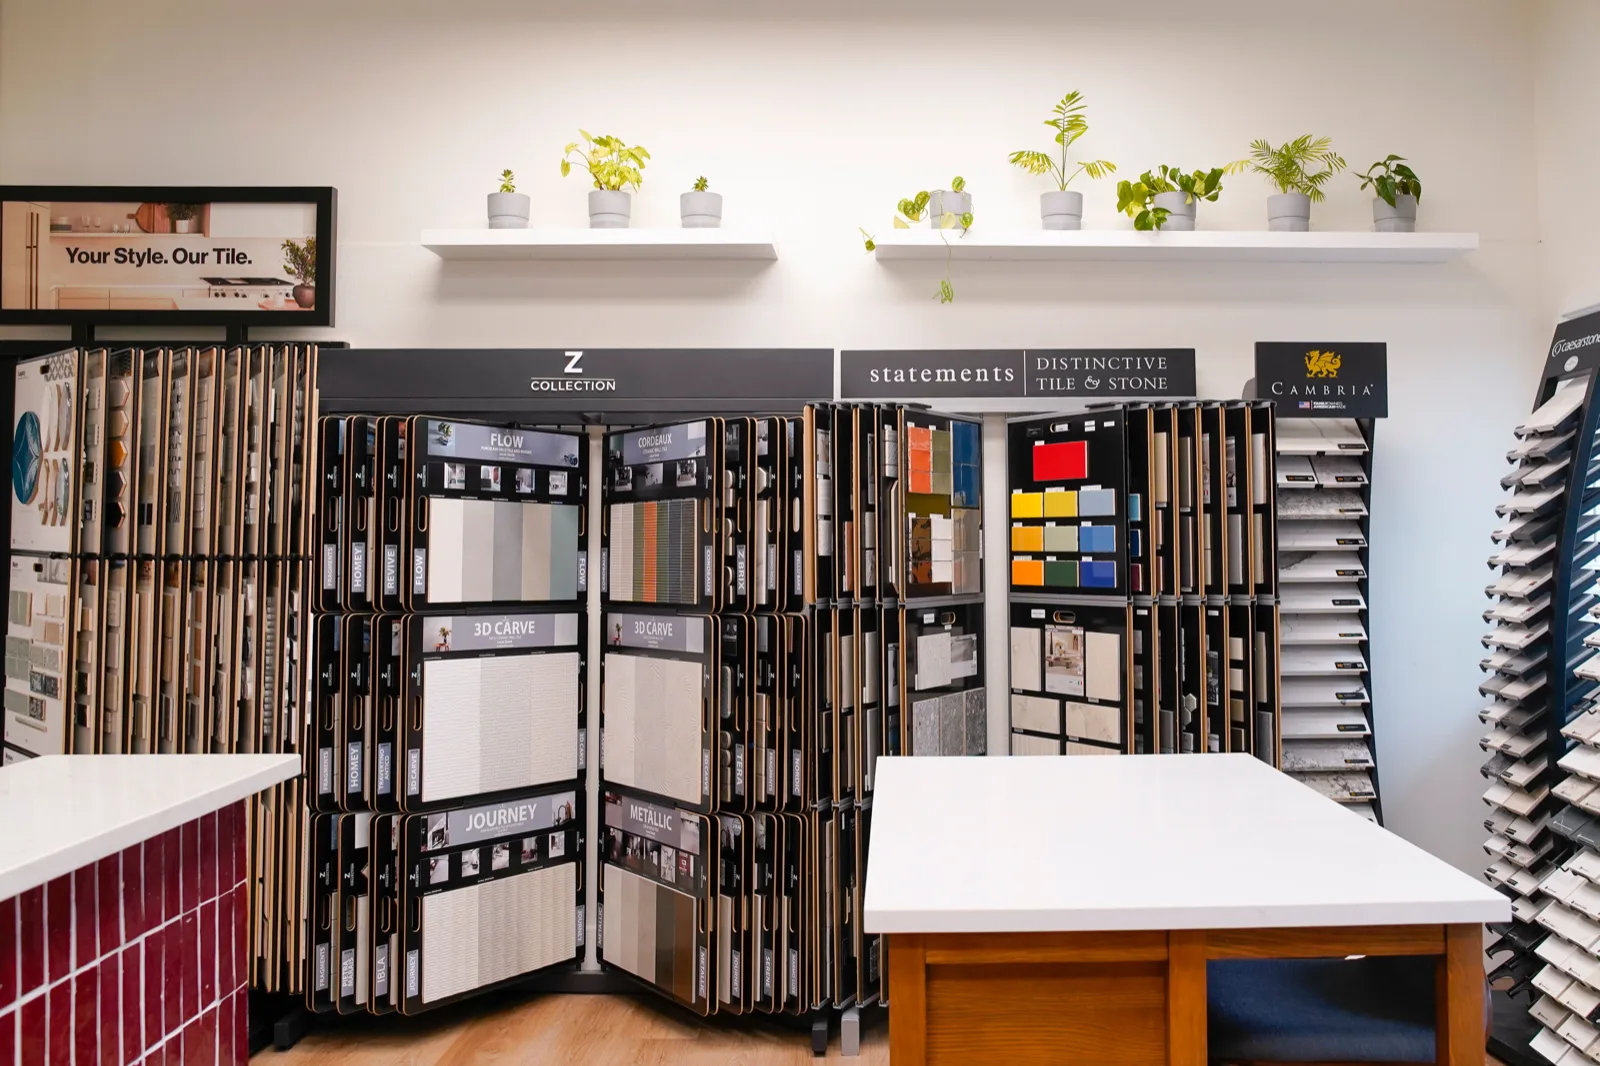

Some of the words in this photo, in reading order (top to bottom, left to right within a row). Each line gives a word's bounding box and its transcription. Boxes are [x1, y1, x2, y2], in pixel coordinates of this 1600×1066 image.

[66, 247, 110, 264] Your
[114, 247, 168, 267] Style.
[172, 247, 208, 264] Our
[213, 247, 252, 264] Tile.
[564, 351, 583, 373] Z
[1036, 357, 1168, 370] DISTINCTIVE
[870, 367, 1014, 383] statements
[1036, 377, 1076, 390] TILE
[1084, 375, 1100, 390] &
[1108, 376, 1168, 390] STONE
[530, 380, 616, 391] COLLECTION
[491, 433, 524, 448] FLOW
[638, 433, 672, 448] CORDEAUX
[353, 547, 362, 587] HOMEY
[387, 550, 395, 589] REVIVE
[474, 622, 491, 636] 3D
[494, 621, 535, 635] CARVE
[634, 621, 645, 634] 3D
[646, 622, 672, 637] CARVE
[351, 747, 359, 788] HOMEY
[466, 803, 537, 831] JOURNEY
[630, 804, 672, 830] METALLIC
[377, 956, 386, 983] IBLA
